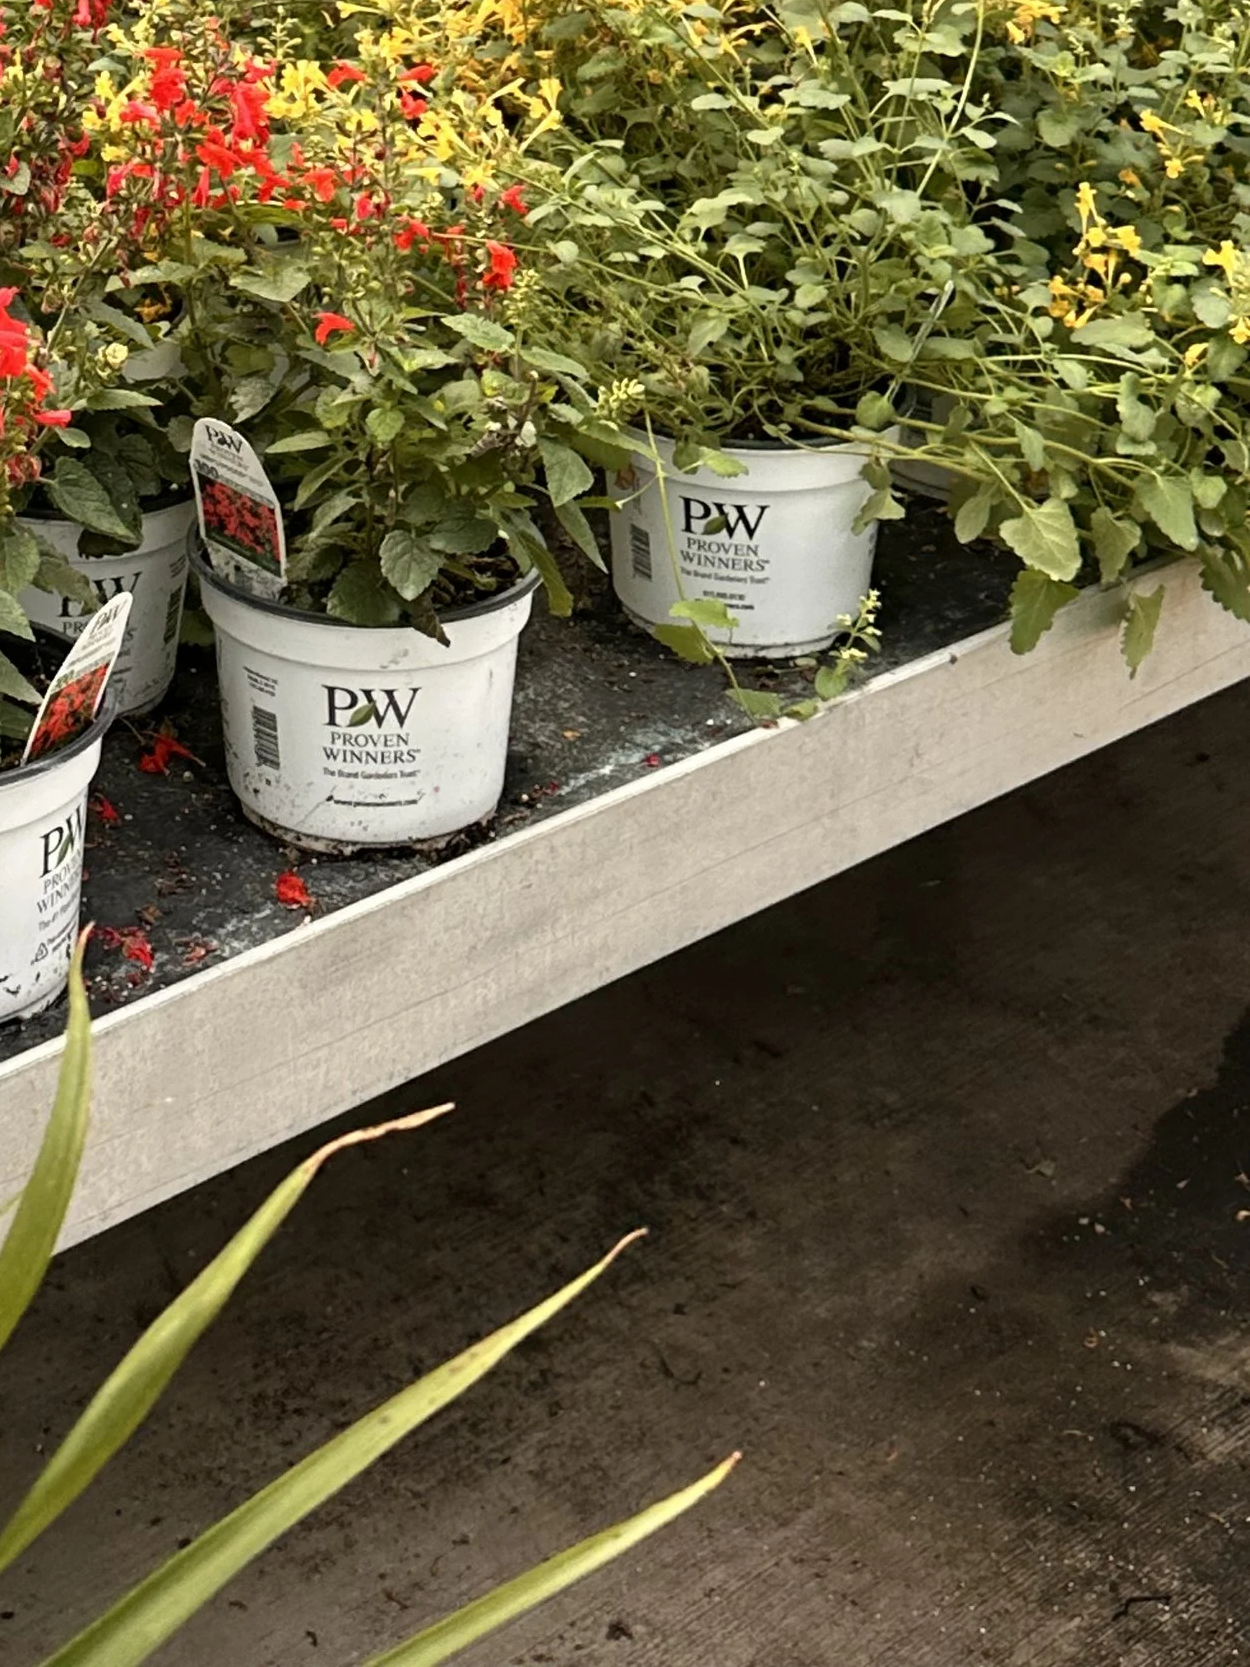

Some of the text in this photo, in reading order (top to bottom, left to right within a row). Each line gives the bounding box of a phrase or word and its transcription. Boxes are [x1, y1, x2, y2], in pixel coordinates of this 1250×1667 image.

[679, 495, 770, 541] PW
[686, 537, 760, 558] PROVEN
[321, 684, 422, 729] PW
[330, 731, 410, 747] PROVEN
[39, 804, 82, 878] PW
